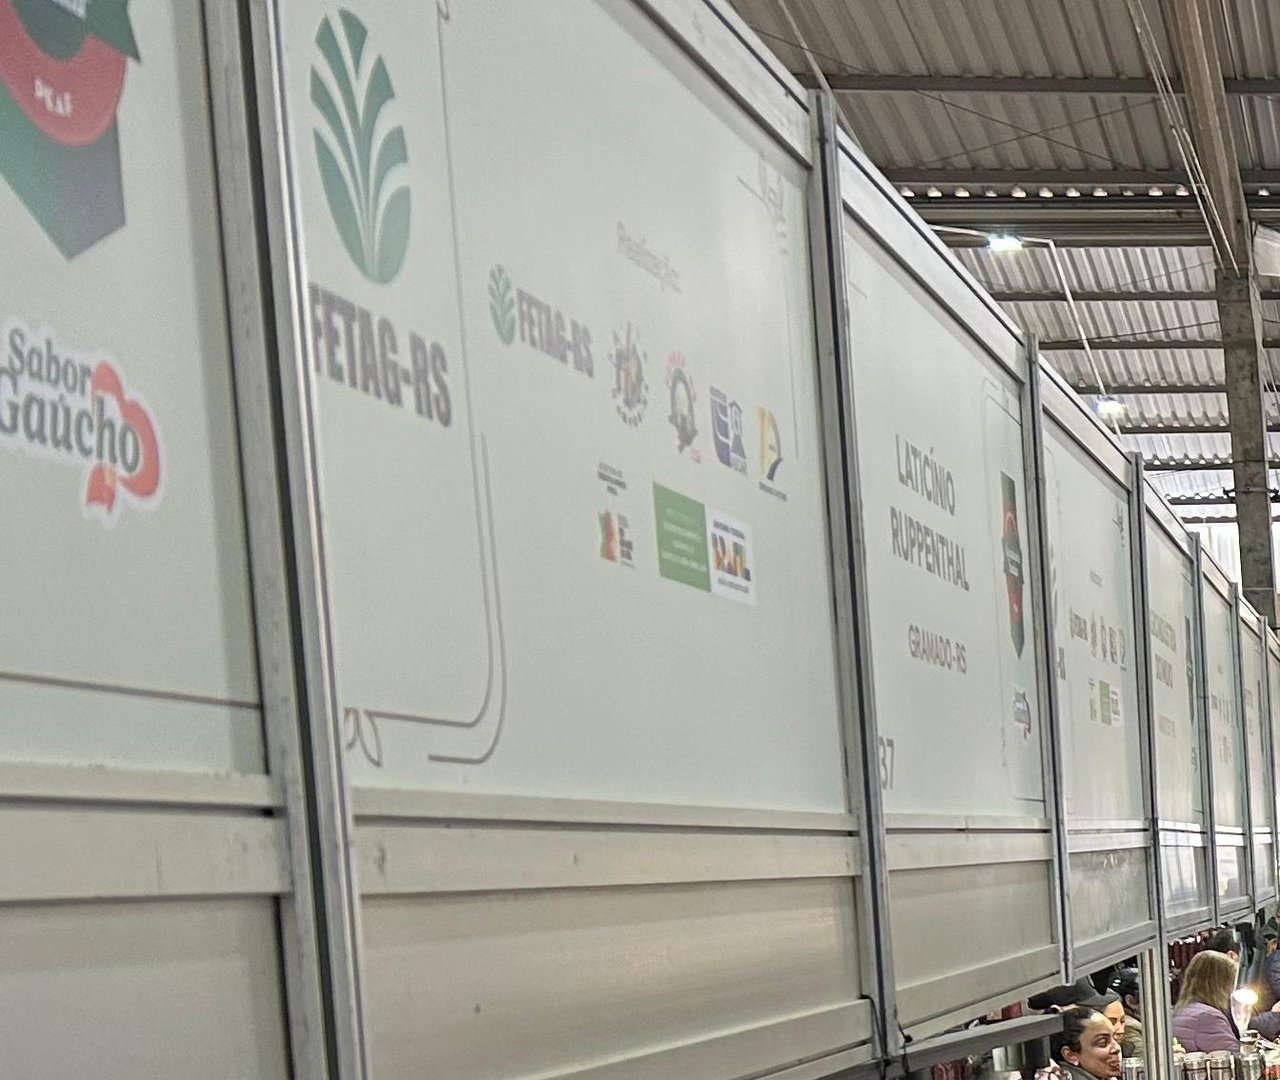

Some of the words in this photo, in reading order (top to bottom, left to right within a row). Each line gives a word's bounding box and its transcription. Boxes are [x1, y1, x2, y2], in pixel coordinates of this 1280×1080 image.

[8, 328, 92, 398] Sabor
[307, 280, 452, 428] FETAG-RS
[515, 287, 594, 379] FETAG-RS
[895, 433, 956, 516] LATICÍNIO
[889, 504, 970, 591] RUPPENTHAL
